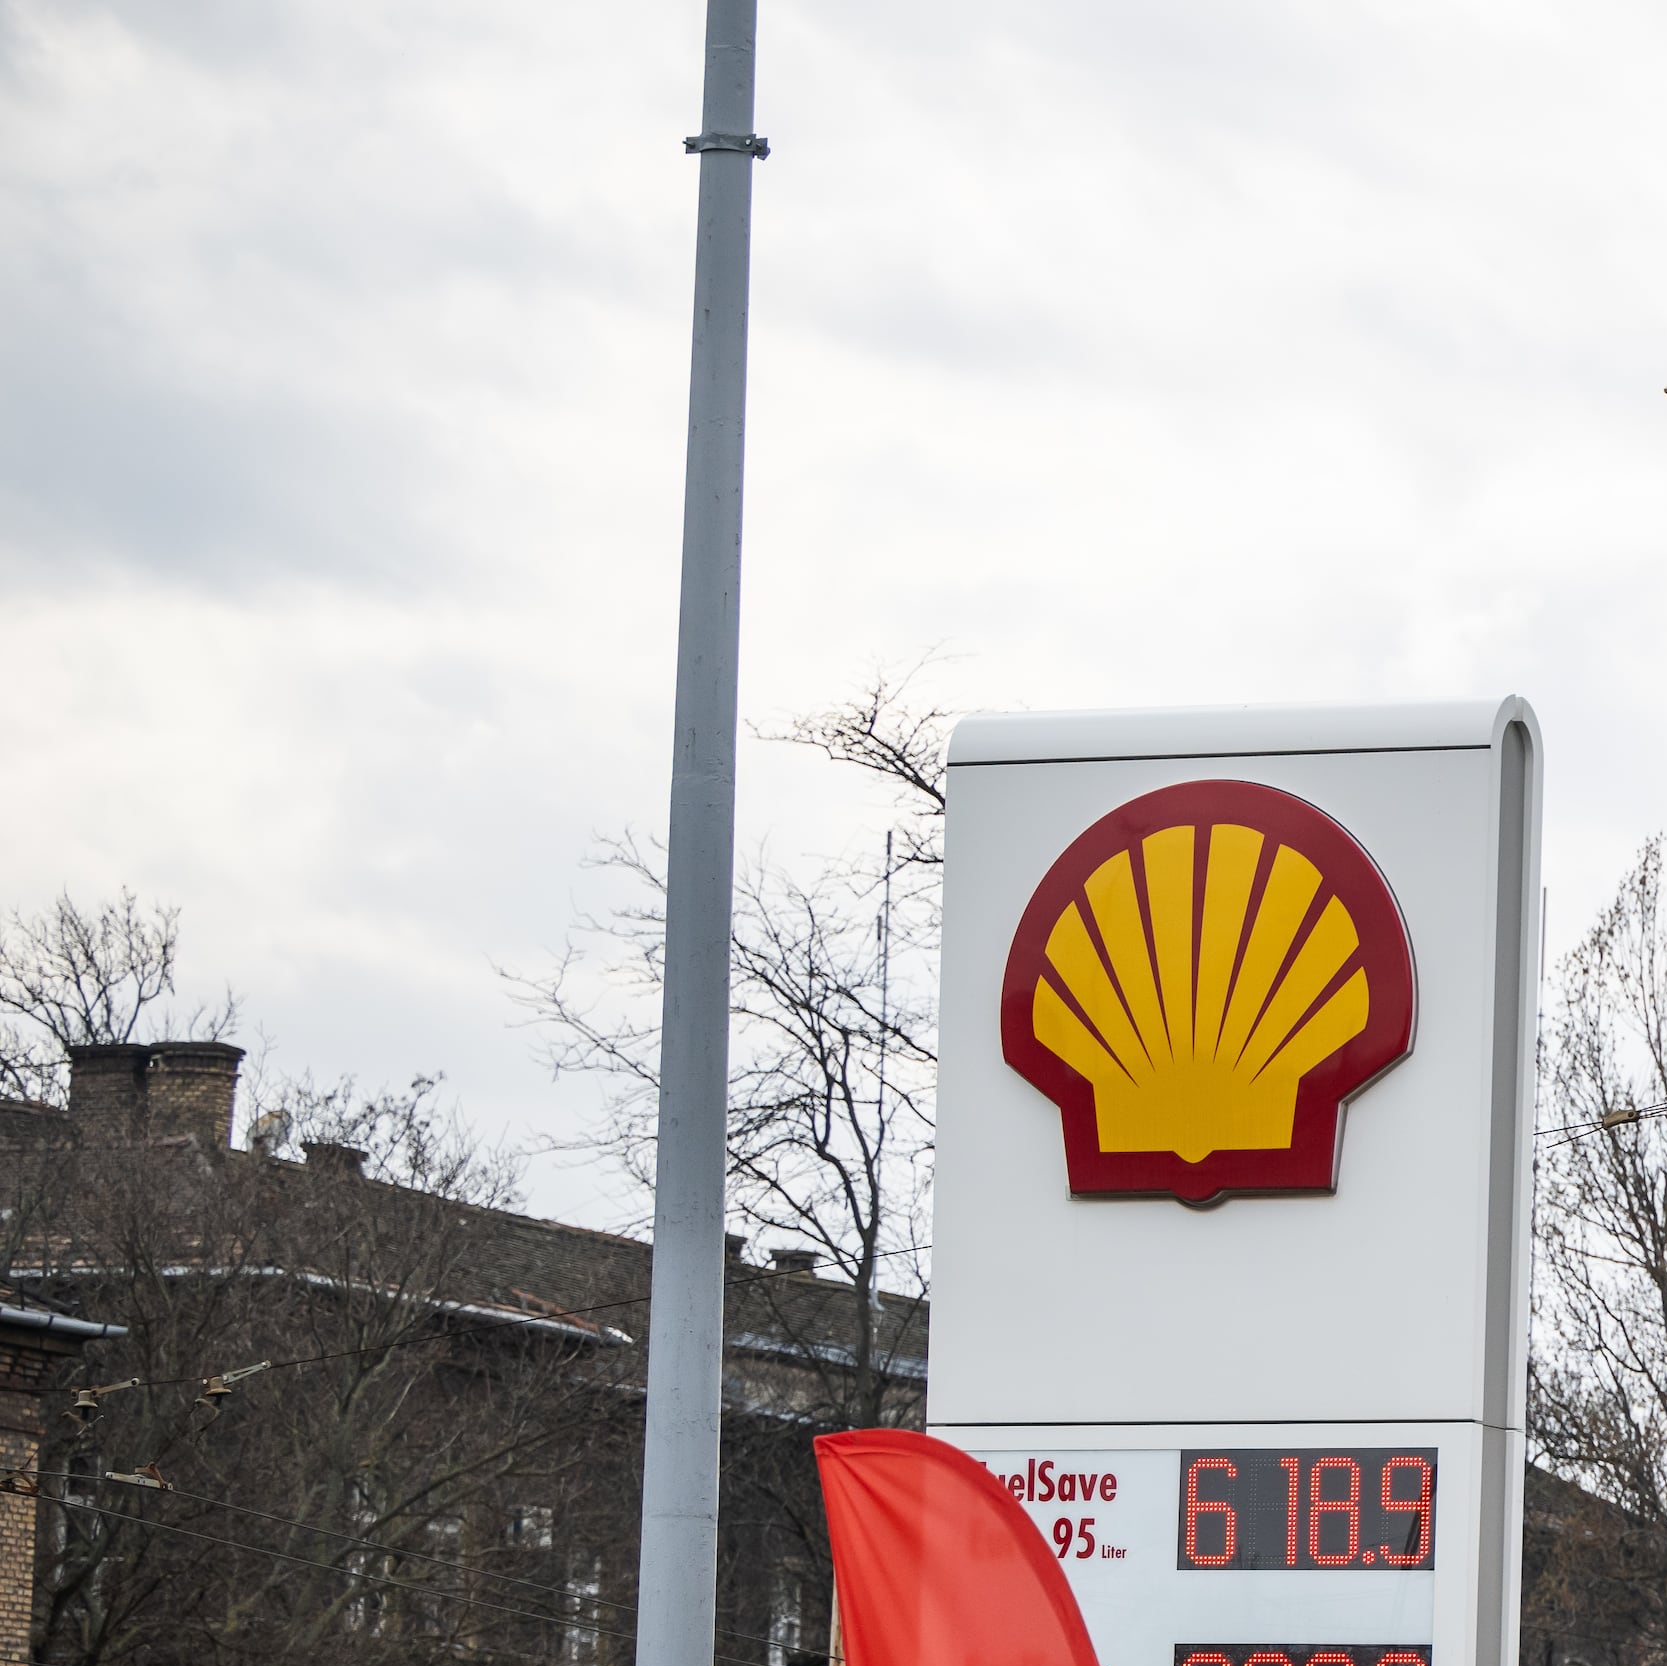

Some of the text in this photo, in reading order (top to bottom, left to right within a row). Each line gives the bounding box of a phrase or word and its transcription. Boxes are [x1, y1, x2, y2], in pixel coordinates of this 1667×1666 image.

[1053, 1517, 1127, 1559] 95 Liter
[1186, 1456, 1432, 1565] 618.9
